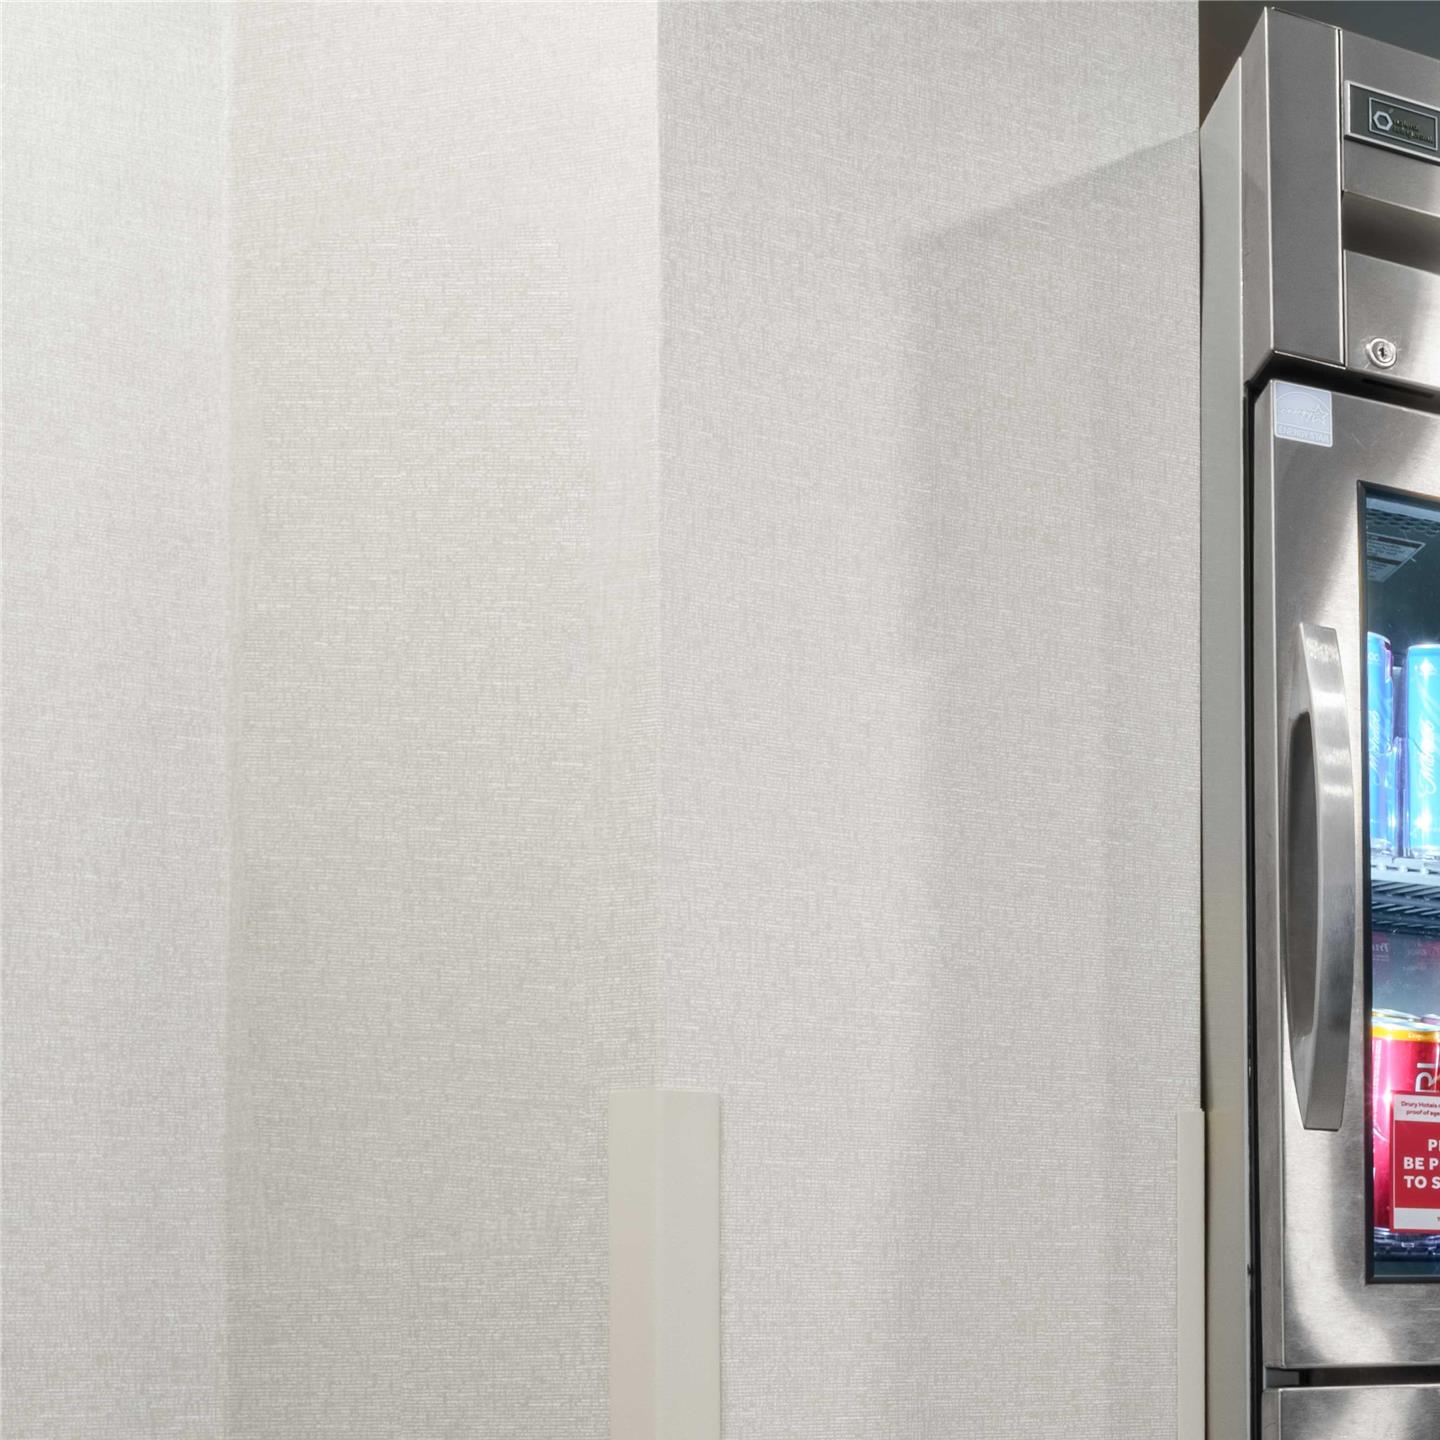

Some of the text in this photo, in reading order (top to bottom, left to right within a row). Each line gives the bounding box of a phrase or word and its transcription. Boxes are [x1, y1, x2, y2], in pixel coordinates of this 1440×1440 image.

[1401, 1101, 1418, 1109] Drury
[1403, 1156, 1425, 1170] BE
[1403, 1175, 1427, 1189] TO
